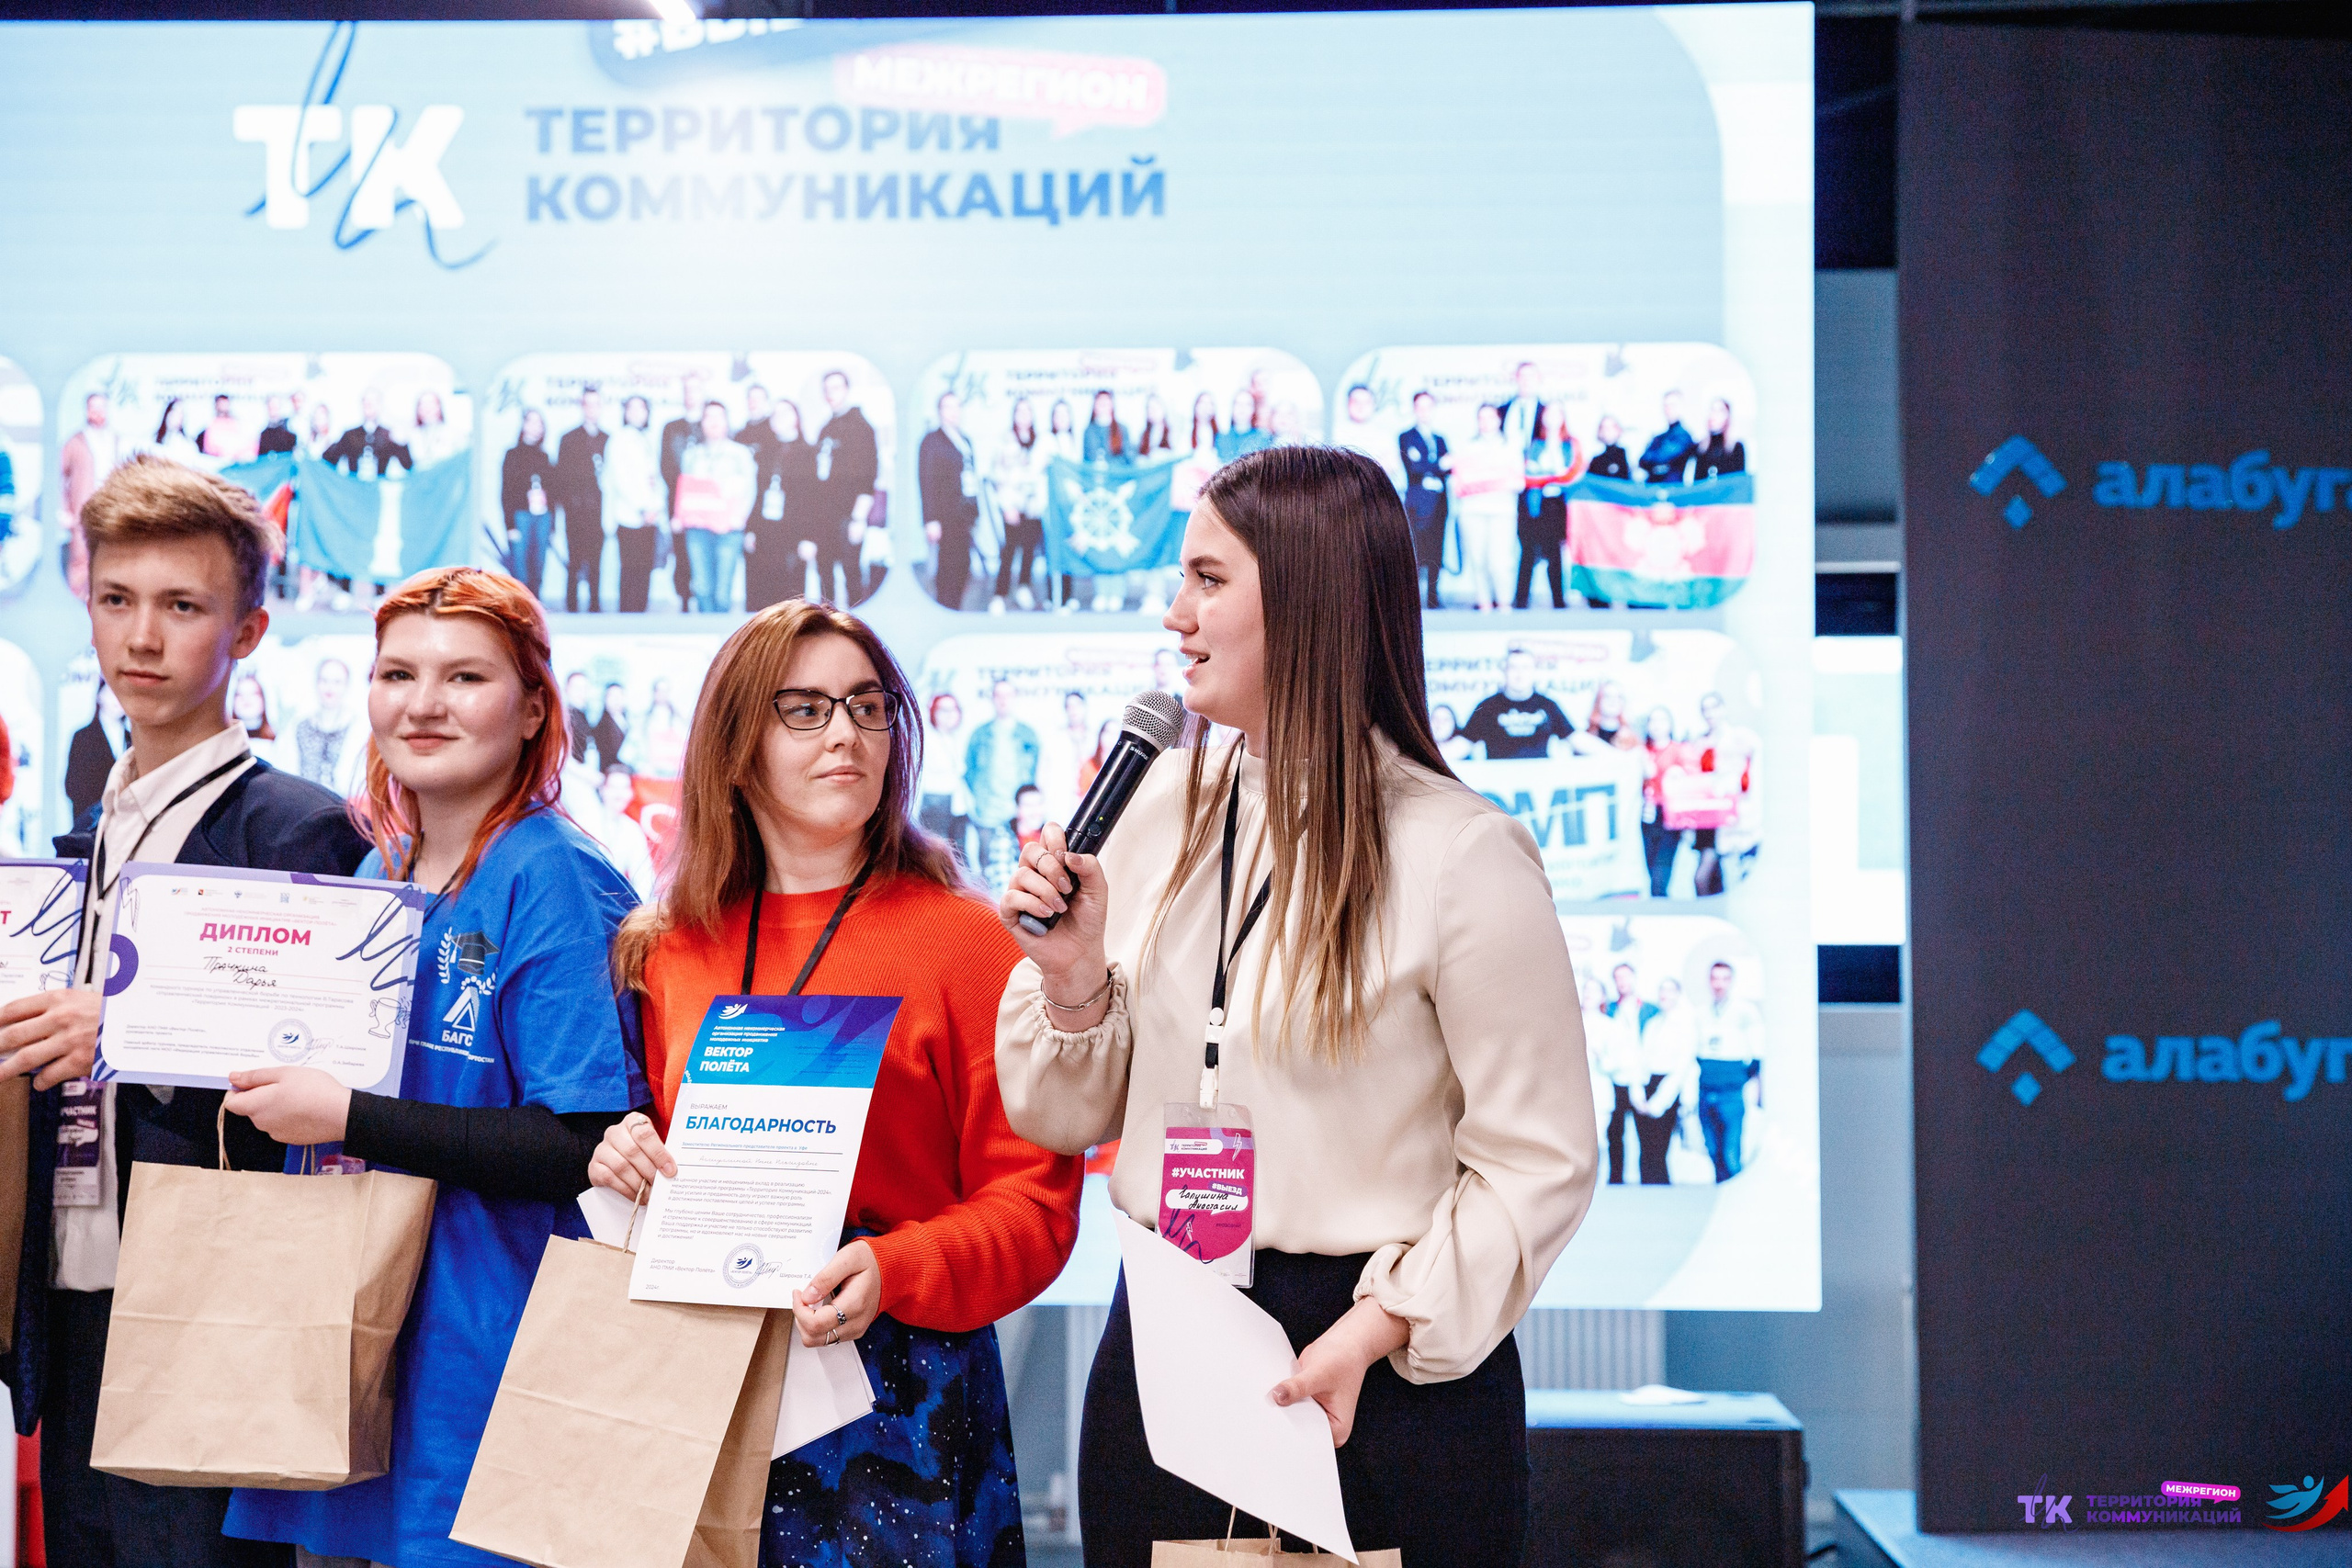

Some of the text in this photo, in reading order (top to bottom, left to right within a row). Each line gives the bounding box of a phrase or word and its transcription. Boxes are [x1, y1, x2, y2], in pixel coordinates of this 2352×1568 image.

[853, 54, 1148, 111] МЕЖРЕГИОН
[526, 106, 1000, 153] ТЕРРИТОРИЯ
[526, 157, 1166, 226] КОММУНИКАЦИЙ
[2092, 448, 2352, 532] алабуг
[1129, 746, 1149, 761] SHURE
[199, 922, 311, 946] ДИПЛОМ
[235, 947, 278, 956] СТЕПЕНИ
[232, 971, 277, 990] Дарья
[441, 1029, 474, 1047] БАГС
[704, 1046, 753, 1057] ВЕКТОР
[699, 1059, 750, 1072] ПОЛЁТА
[690, 1102, 728, 1111] ВЫРАЖАЕМ
[685, 1115, 837, 1134] БЛАГОДАРНОСТЬ
[1171, 1168, 1245, 1179] #УЧАСТНИК
[1211, 1182, 1243, 1196] #ВЫЕЗД
